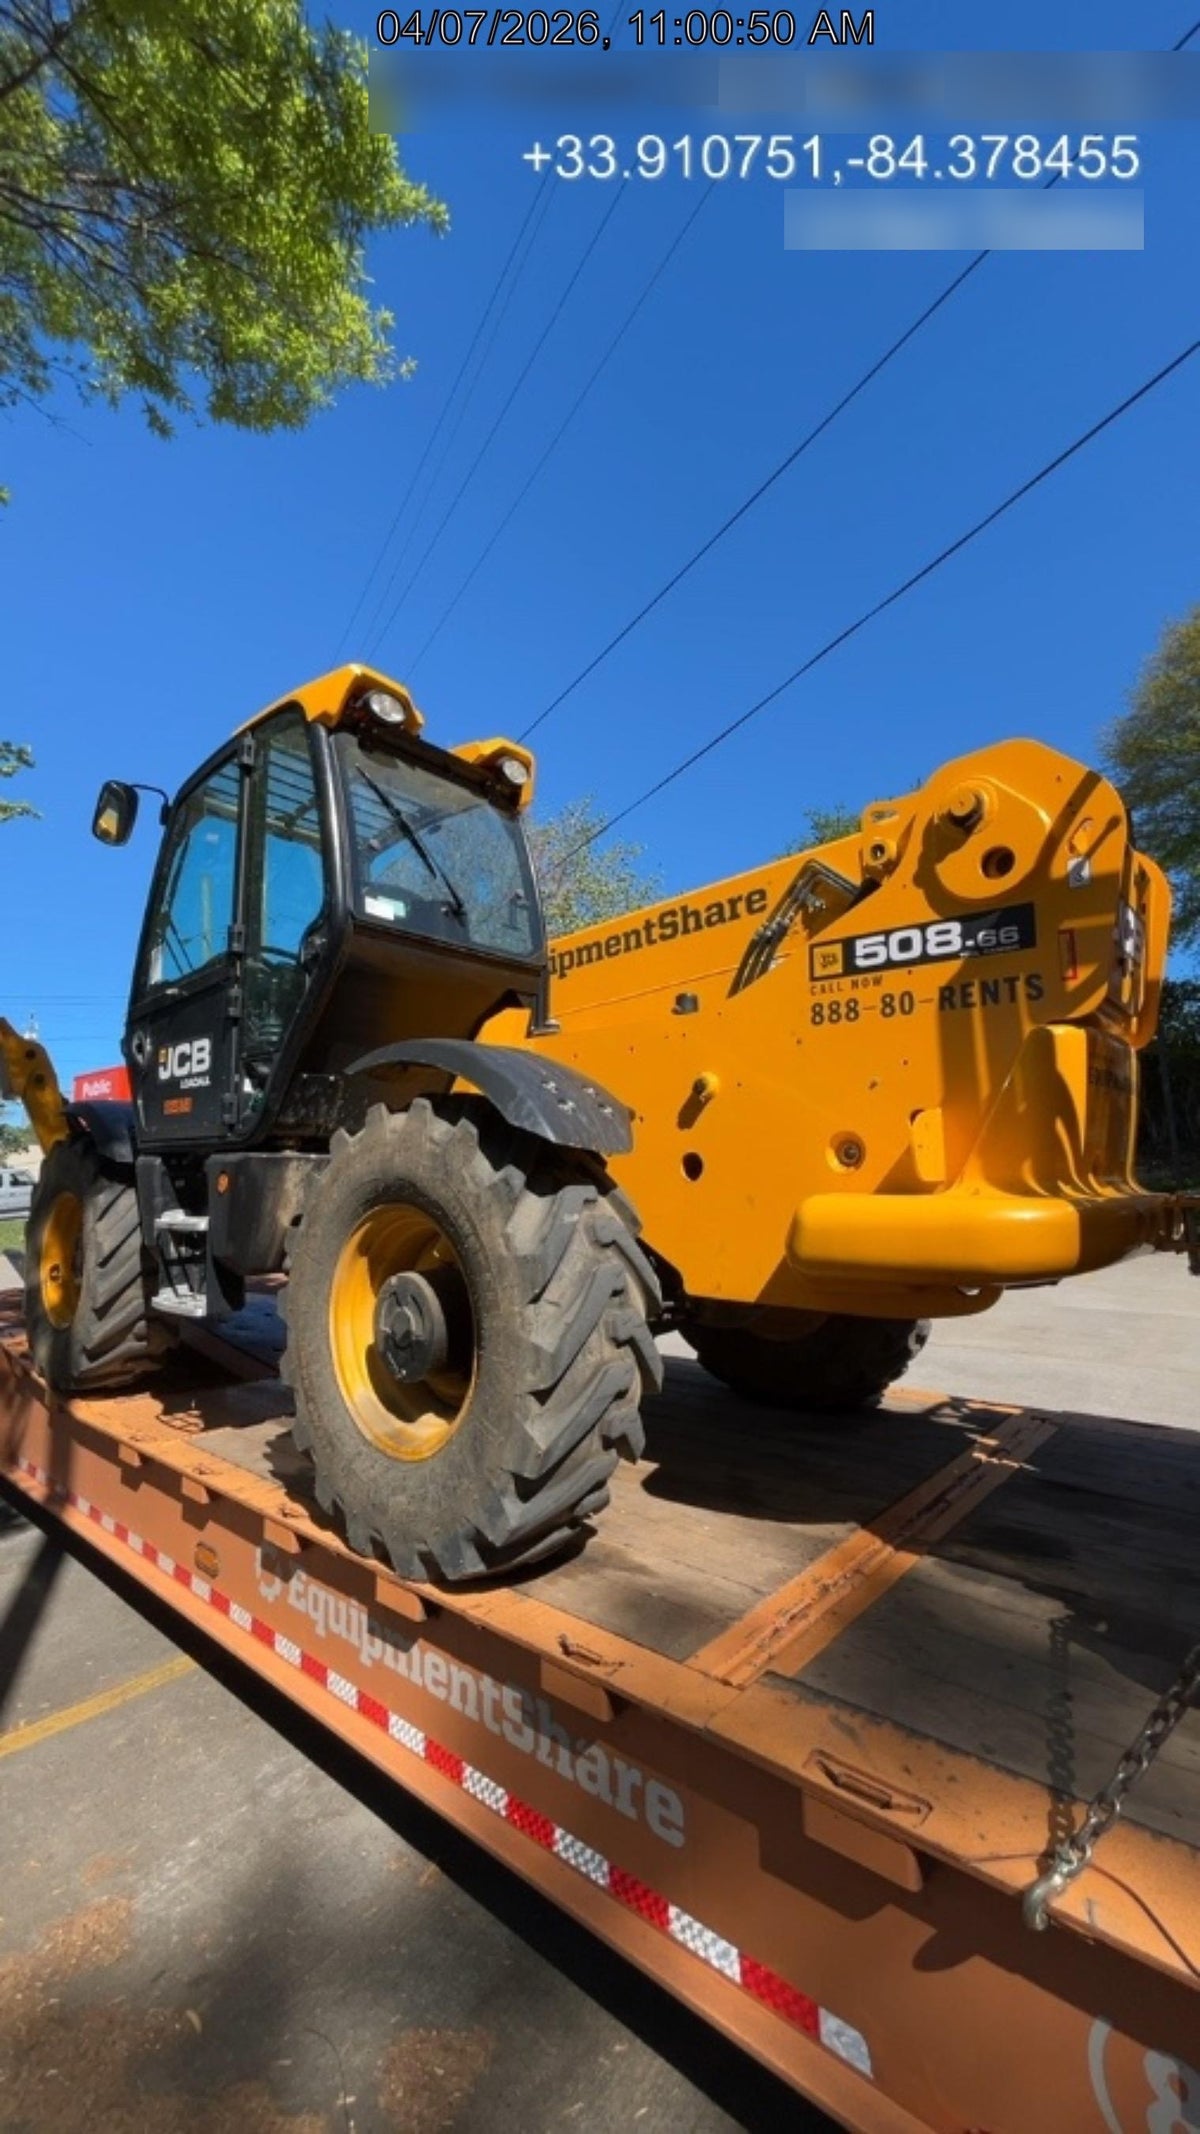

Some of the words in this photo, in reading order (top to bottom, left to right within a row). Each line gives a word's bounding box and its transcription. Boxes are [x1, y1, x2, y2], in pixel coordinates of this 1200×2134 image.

[851, 975, 883, 989] NOW
[158, 1038, 211, 1080] JCB
[287, 1570, 686, 1849] EquipmentShare
